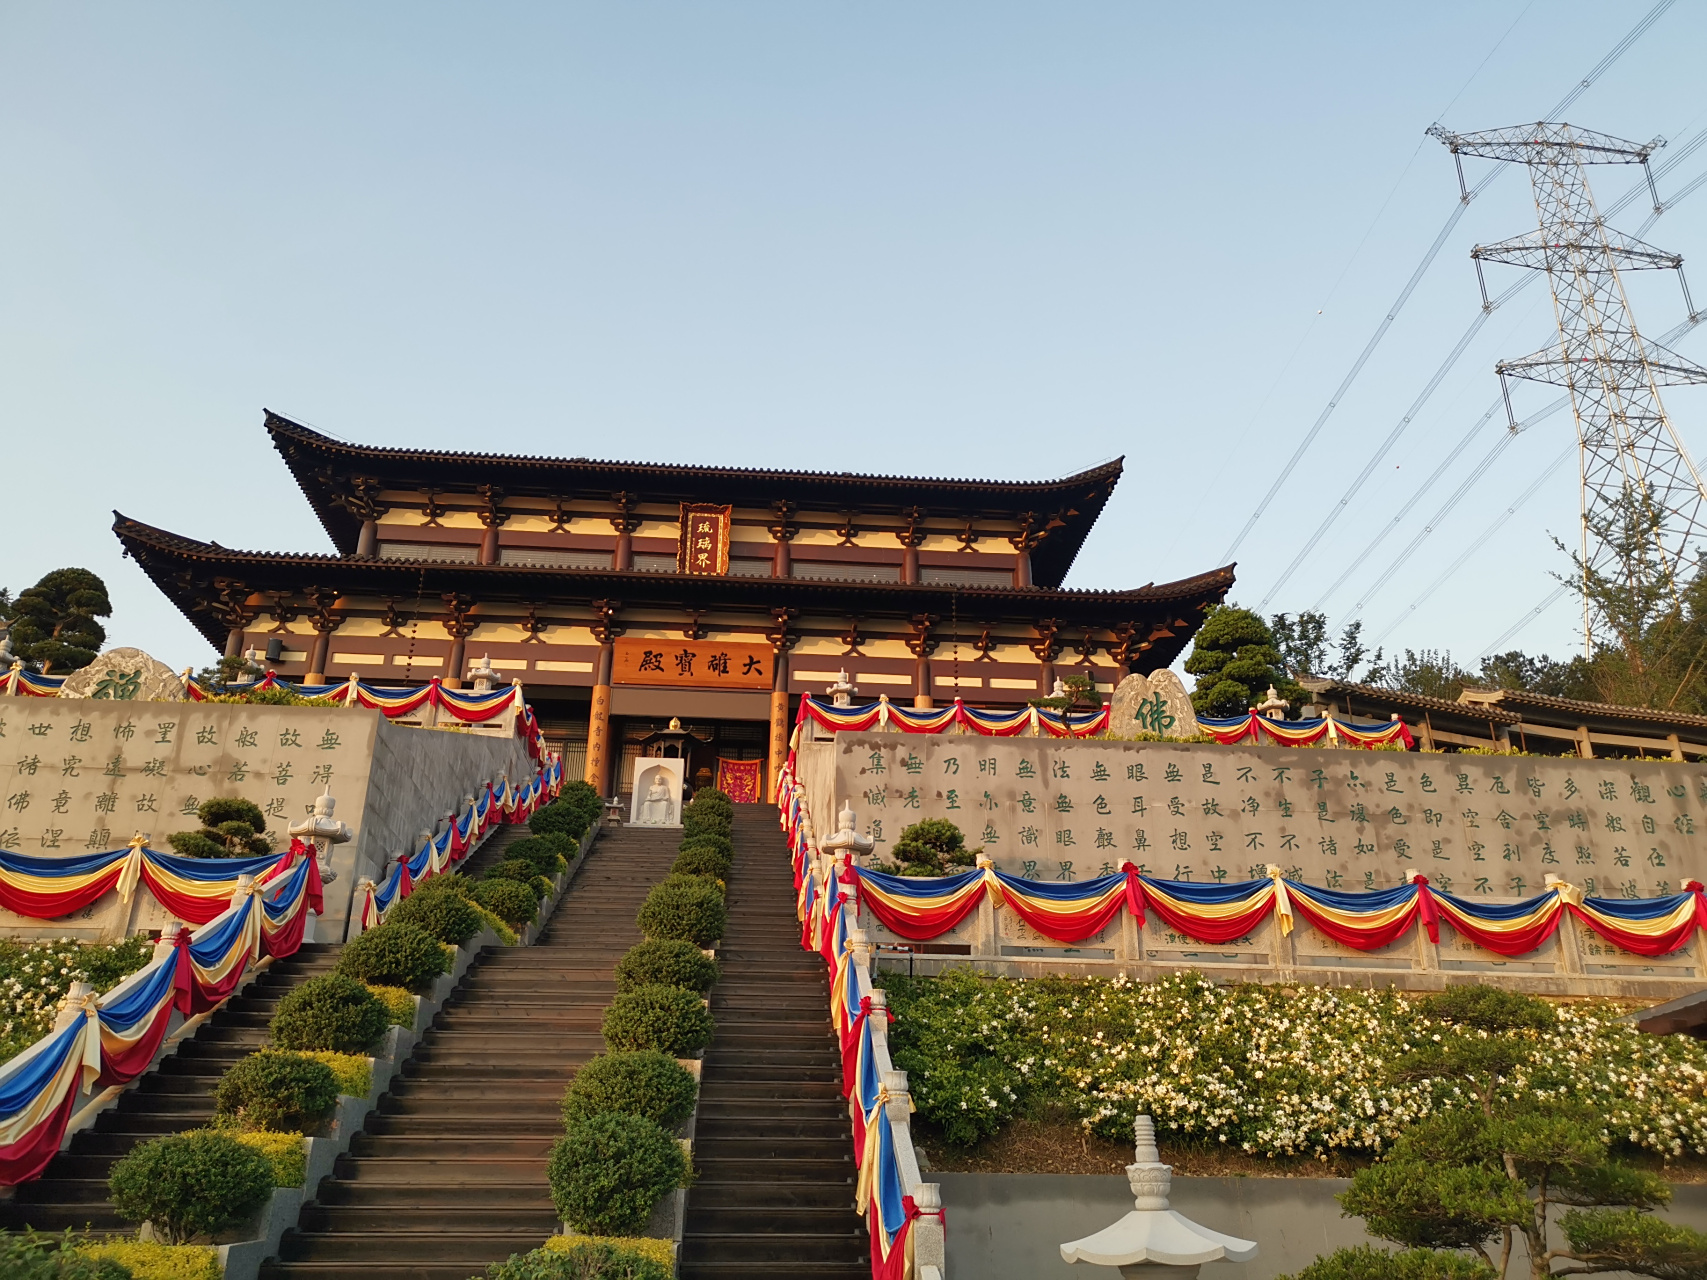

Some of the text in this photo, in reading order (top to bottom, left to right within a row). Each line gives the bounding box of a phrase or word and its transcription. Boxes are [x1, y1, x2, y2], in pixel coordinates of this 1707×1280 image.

[696, 521, 713, 568] 琉璃界
[1134, 692, 1175, 738] 佛
[903, 752, 924, 828] 無老
[979, 757, 1002, 873] 明亦無
[1385, 772, 1412, 886] 是色受
